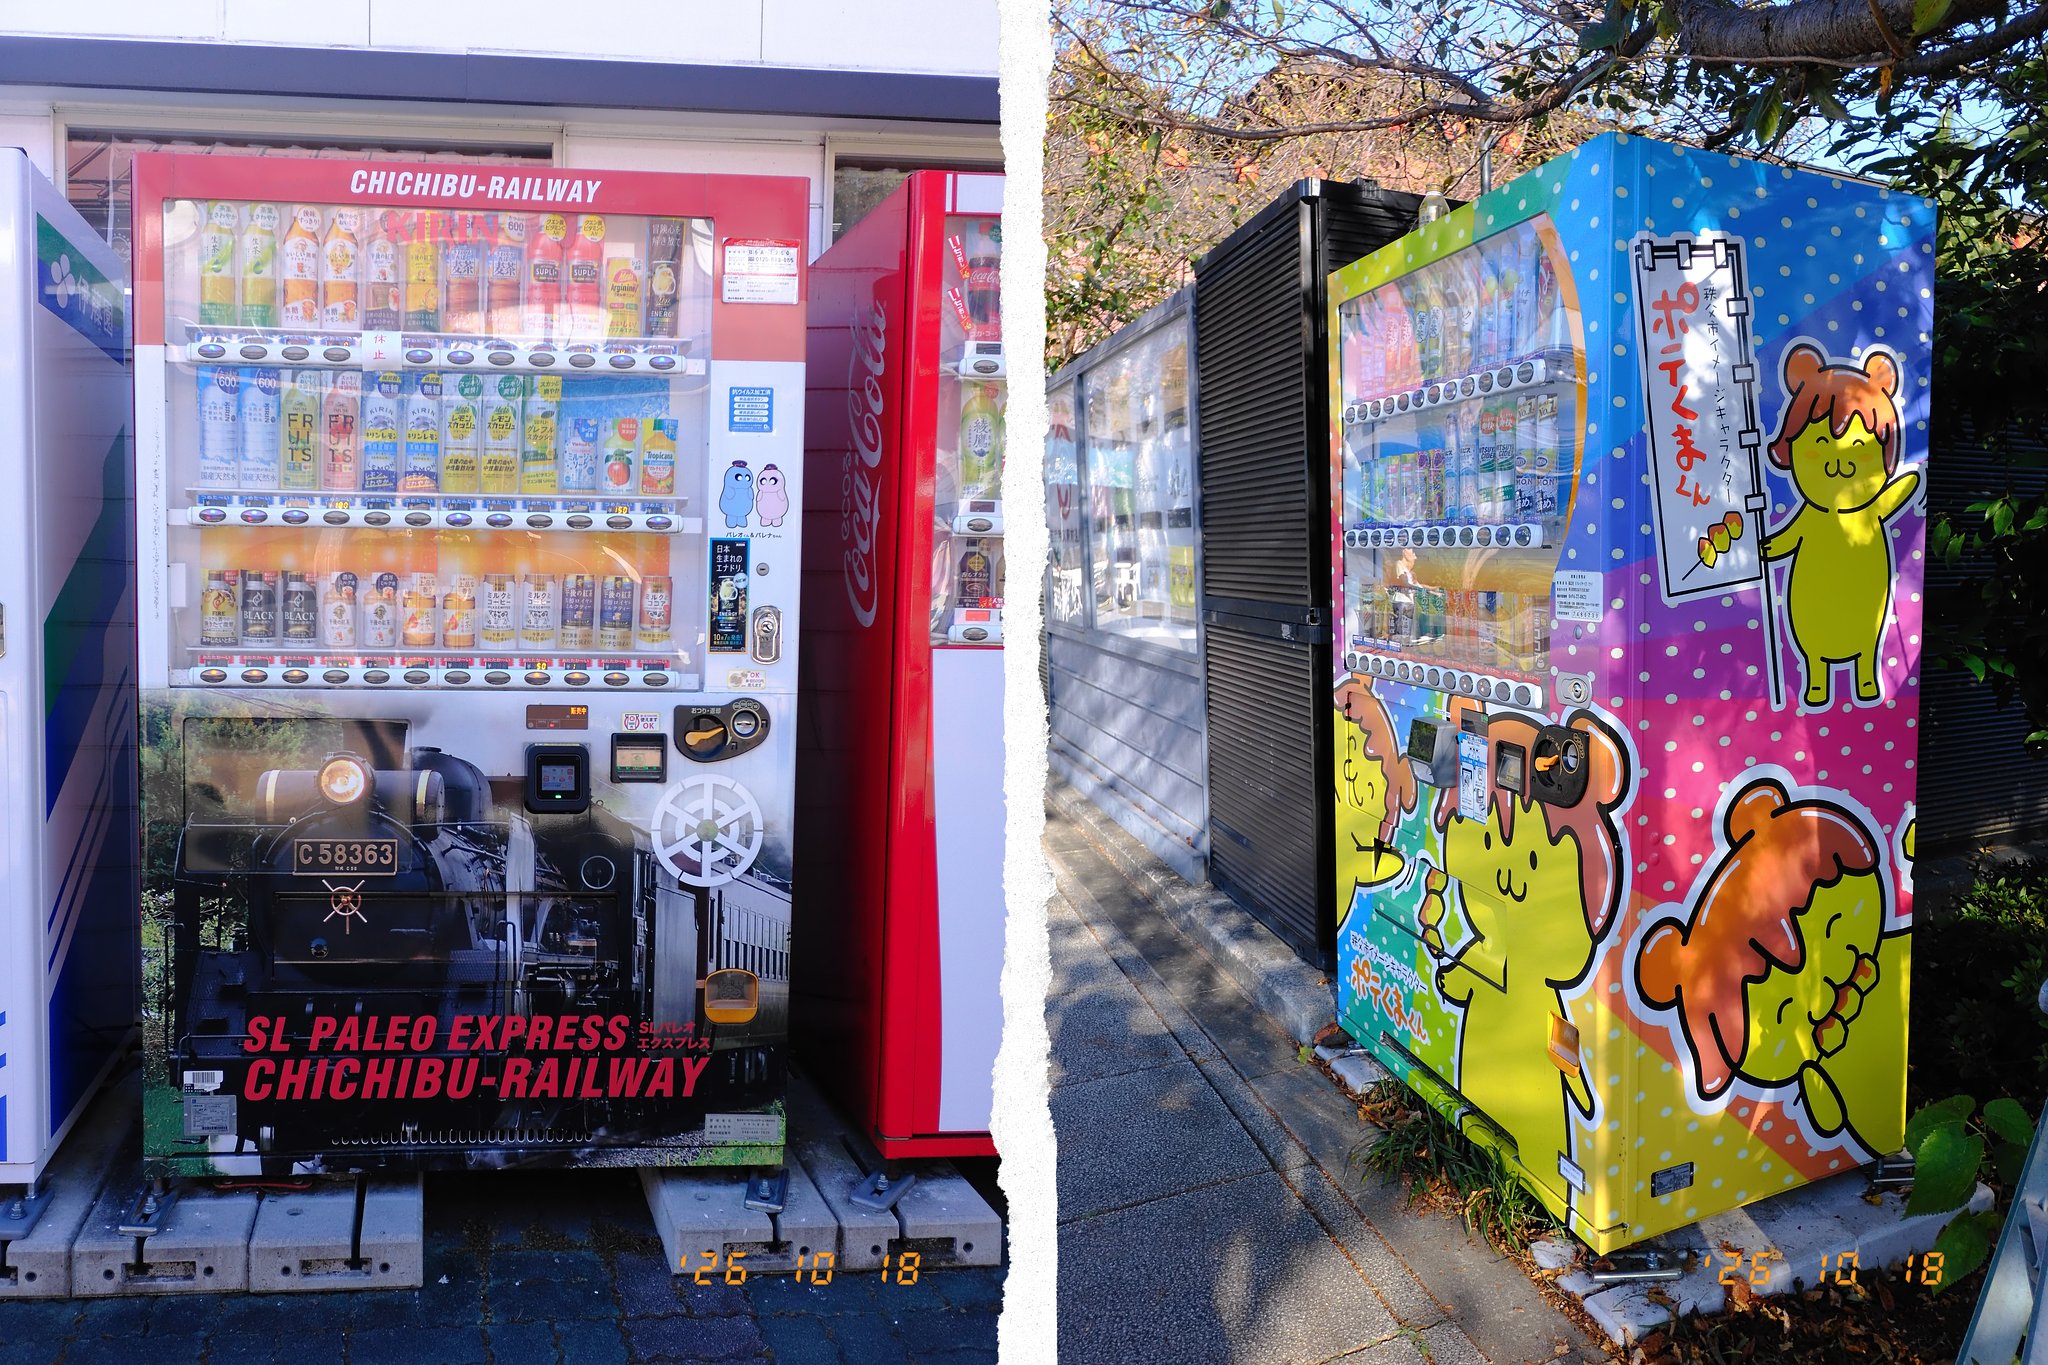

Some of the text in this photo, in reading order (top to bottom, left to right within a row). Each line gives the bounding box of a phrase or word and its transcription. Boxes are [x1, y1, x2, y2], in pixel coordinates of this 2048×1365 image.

[350, 169, 602, 203] CHICHIBU-RAILWAY
[373, 333, 387, 361] 休止
[218, 376, 238, 388] 600
[258, 378, 277, 389] 600
[1651, 281, 1712, 508] ポテくまくん
[1703, 286, 1732, 504] 秩父市イメージキャラクター
[369, 406, 395, 416] KIRIN
[411, 407, 436, 417] KIRIN
[973, 418, 989, 448] 綾鷹
[843, 299, 887, 629] Coca-Cola
[716, 545, 731, 553] 日本
[715, 554, 743, 563] 生まれの
[243, 611, 275, 620] BLACK
[284, 611, 316, 620] BLACK
[570, 706, 587, 715] 販売中
[642, 722, 655, 730] OK
[318, 843, 393, 865] 58363
[1352, 957, 1427, 1041] ポテくまくん
[243, 1014, 631, 1053] SL PALEO EXPRESS
[638, 1021, 696, 1035] SLパレオ
[637, 1036, 711, 1050] エクスプレス
[243, 1057, 712, 1102] CHICHIBU-RAILWAY
